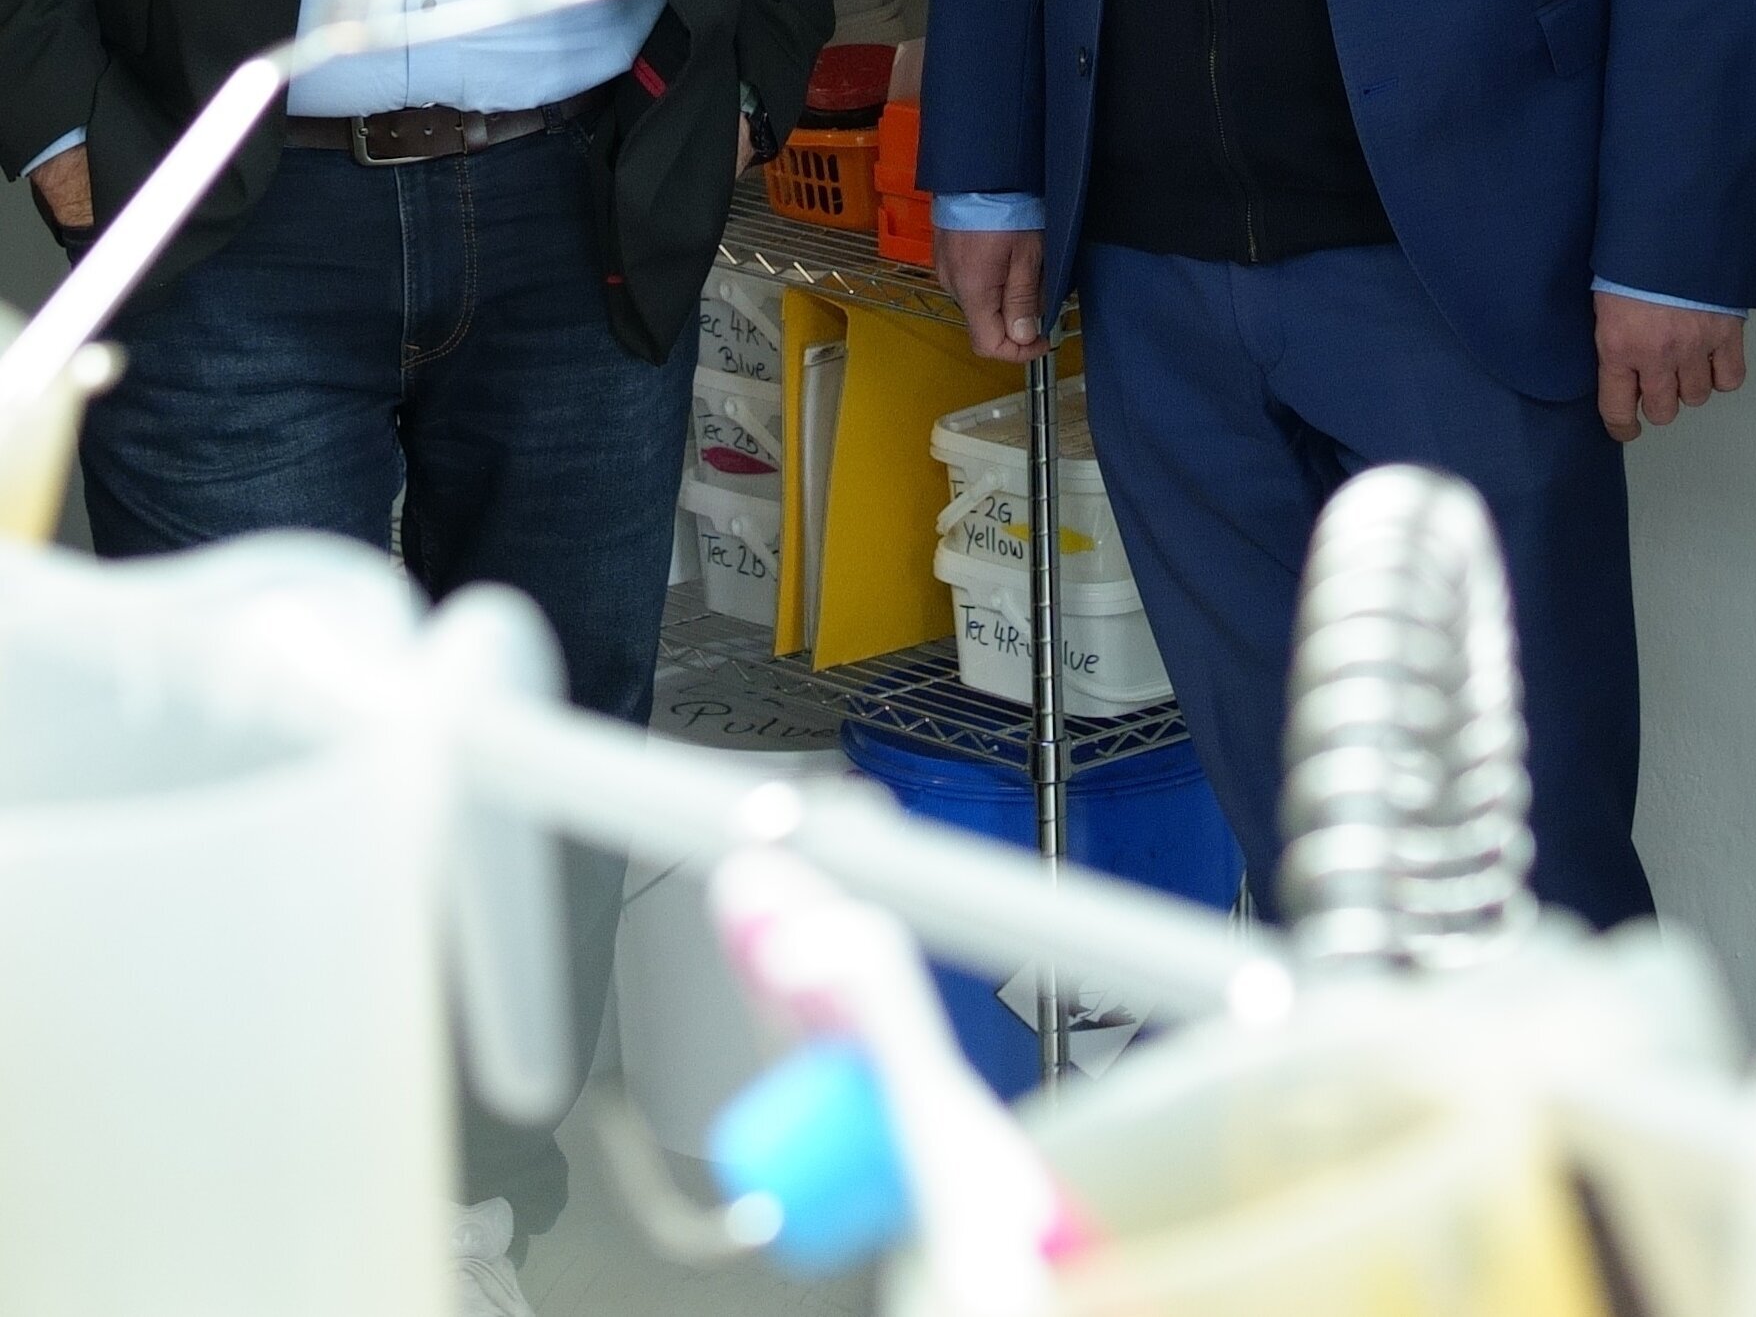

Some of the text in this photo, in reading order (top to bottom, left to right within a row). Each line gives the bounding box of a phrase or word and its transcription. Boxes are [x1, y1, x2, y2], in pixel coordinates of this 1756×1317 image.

[718, 346, 772, 381] Blue
[701, 534, 733, 568] Tec
[964, 522, 1024, 560] Yellow
[959, 604, 989, 646] Tec
[1063, 640, 1100, 674] lue
